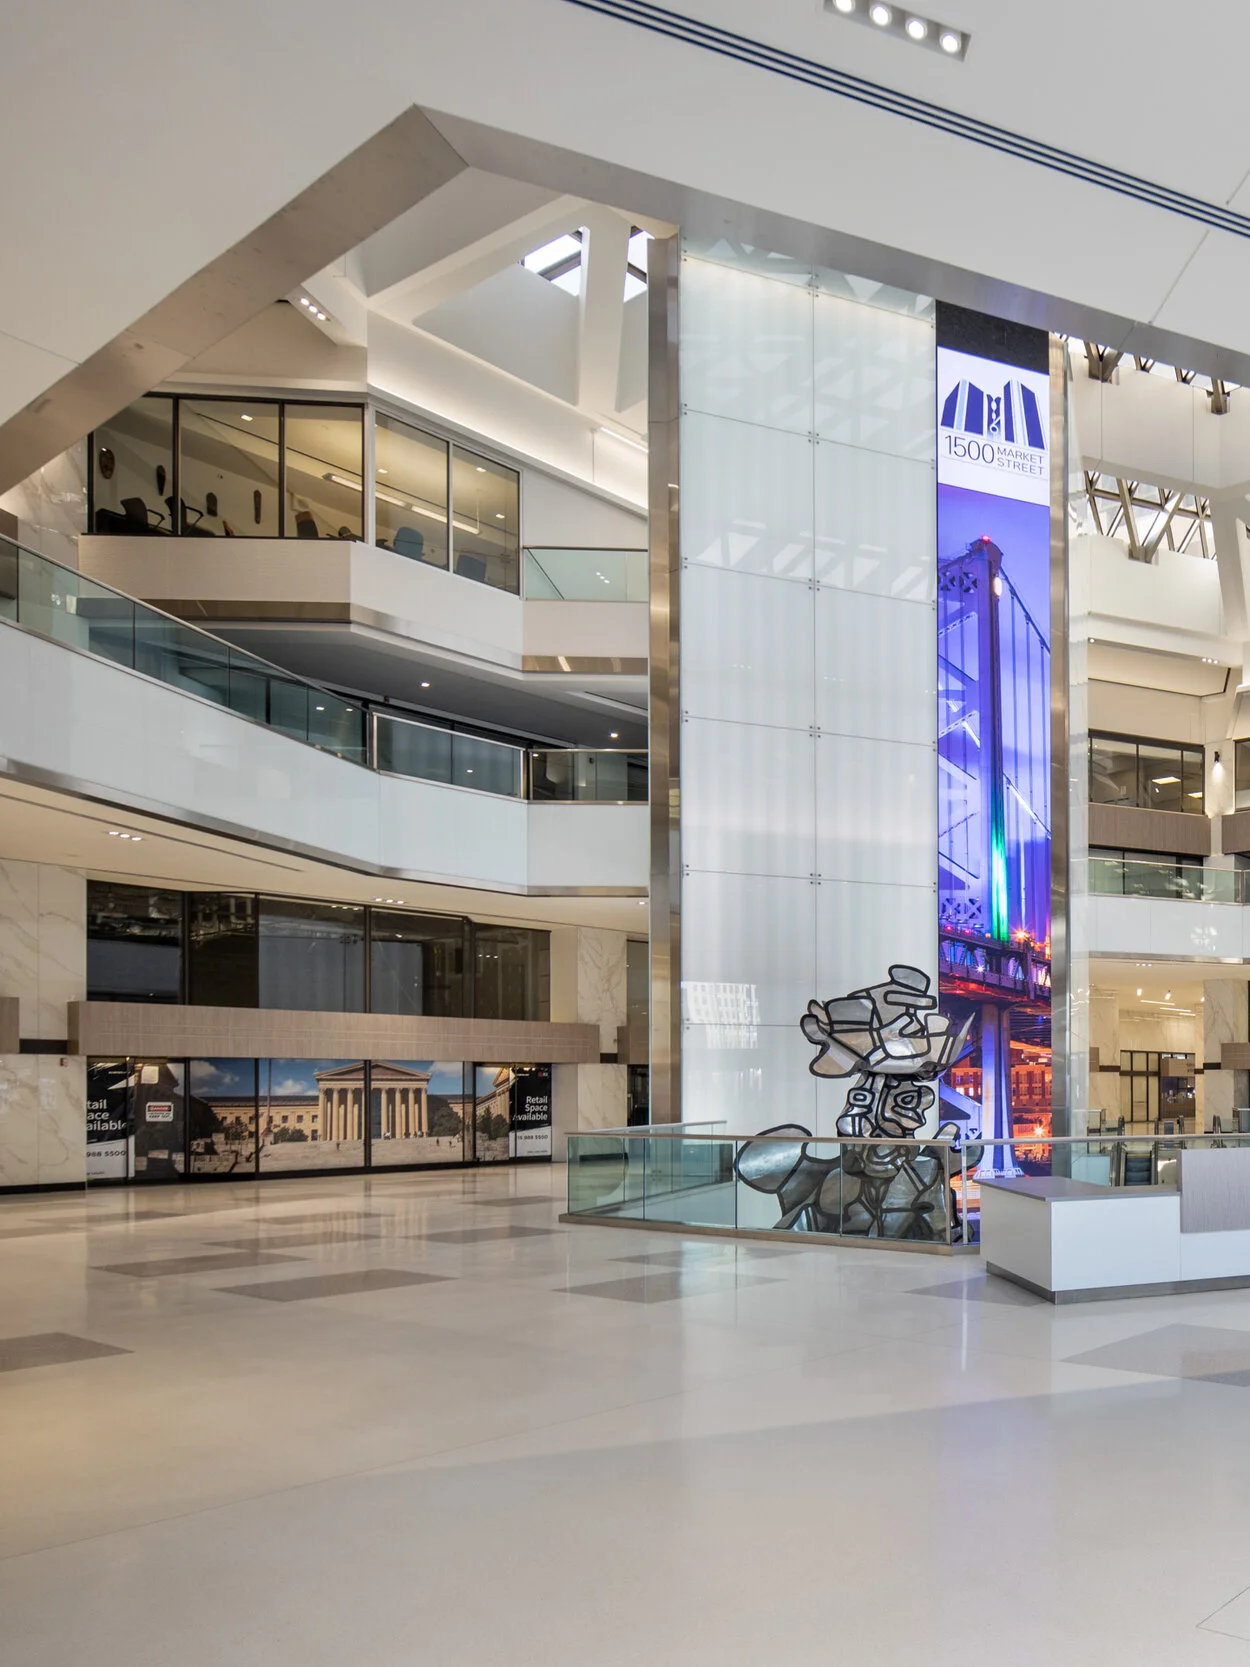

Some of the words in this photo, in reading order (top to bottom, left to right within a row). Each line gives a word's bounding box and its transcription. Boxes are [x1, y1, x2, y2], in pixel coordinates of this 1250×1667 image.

[945, 435, 994, 464] 1500
[997, 446, 1044, 465] MARKET
[997, 457, 1044, 475] STREET
[86, 1099, 107, 1110] tail
[526, 1096, 548, 1104] Retail
[525, 1104, 548, 1113] Space
[86, 1111, 110, 1120] ace
